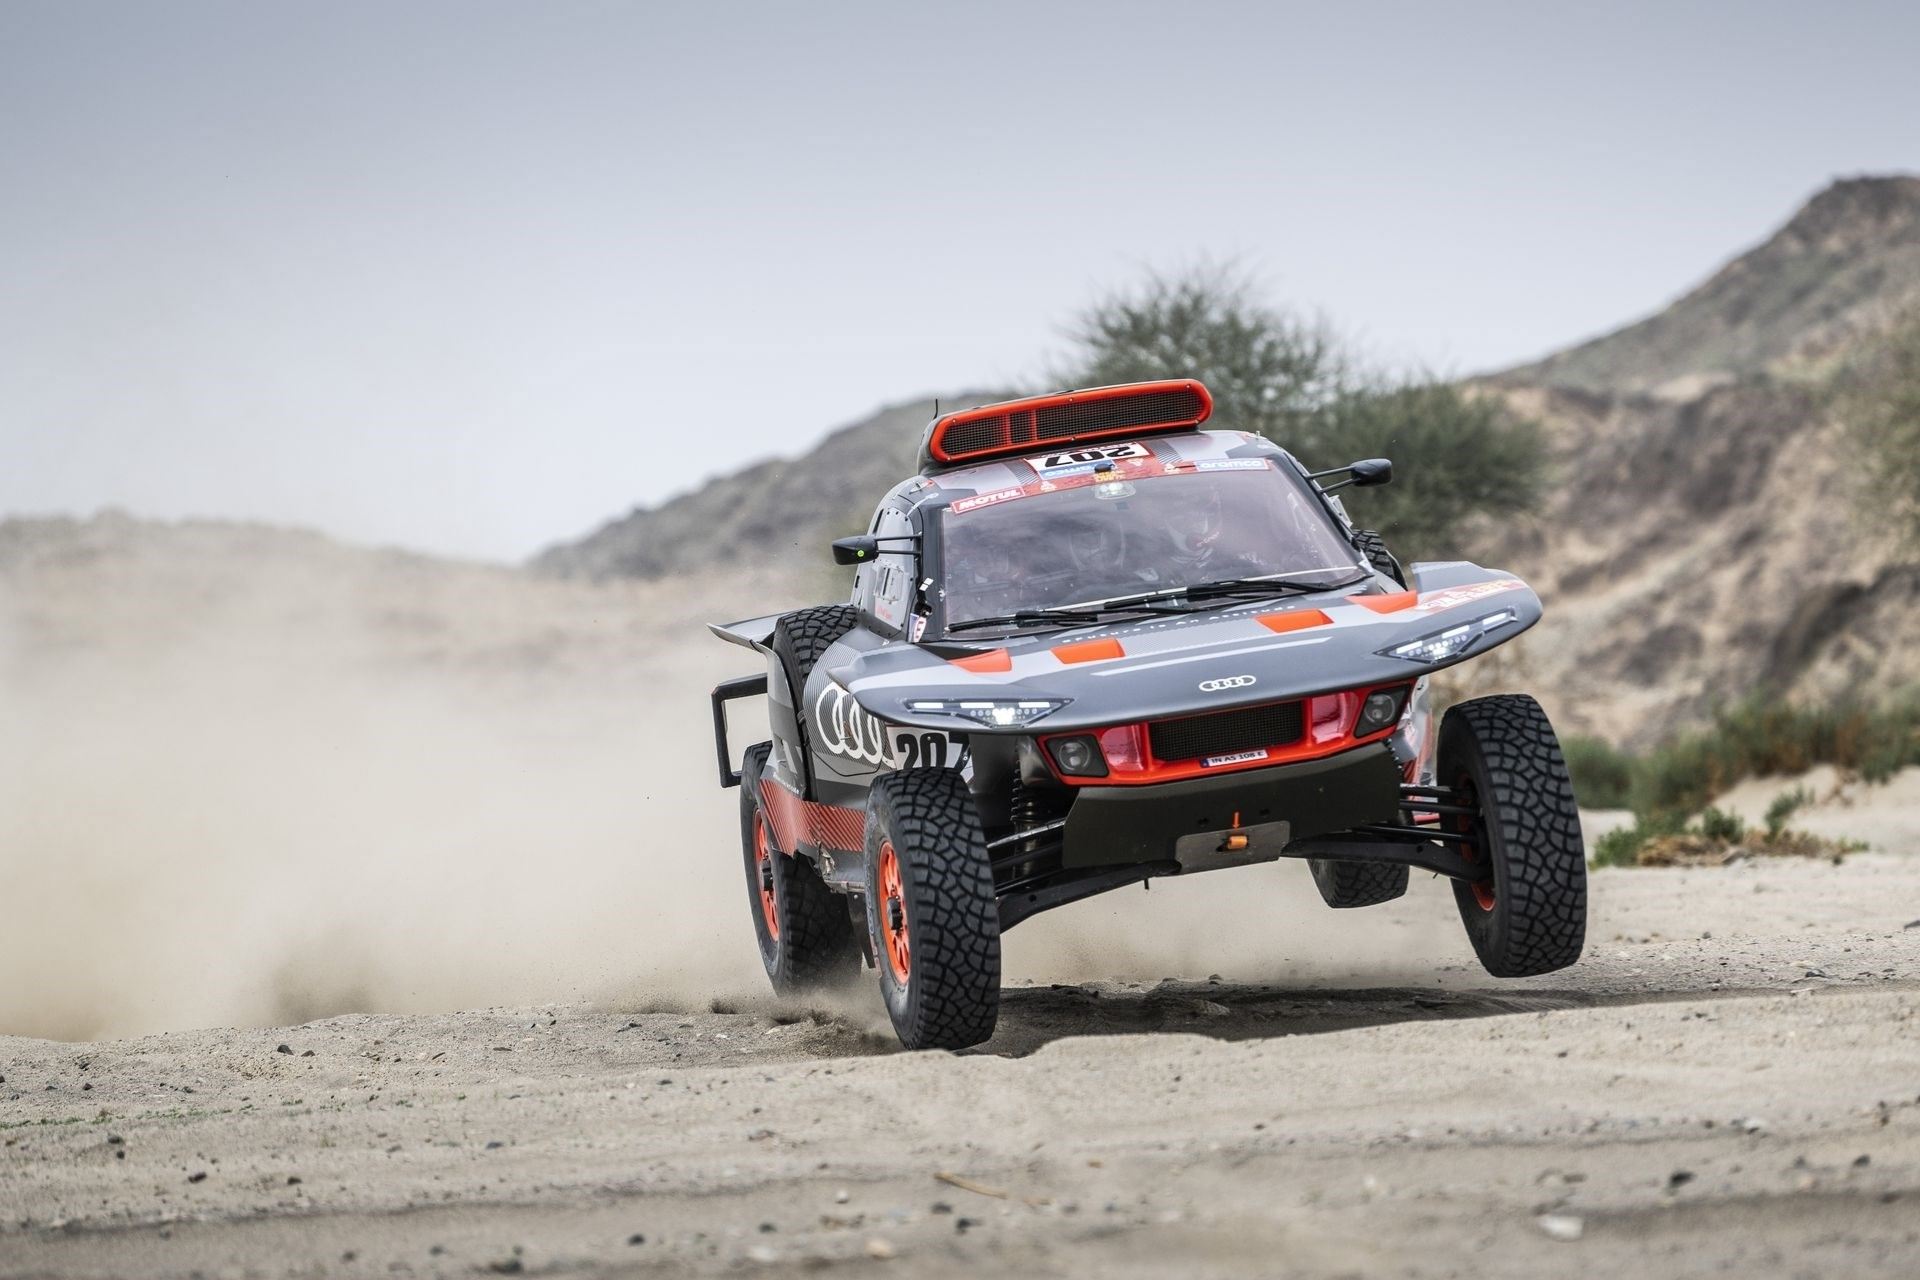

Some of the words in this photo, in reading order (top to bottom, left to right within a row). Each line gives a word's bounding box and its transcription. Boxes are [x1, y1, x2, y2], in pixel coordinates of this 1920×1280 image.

[1045, 446, 1135, 468] 207
[1199, 459, 1263, 469] aramco
[959, 488, 1021, 511] MOTUL
[896, 731, 972, 775] 207
